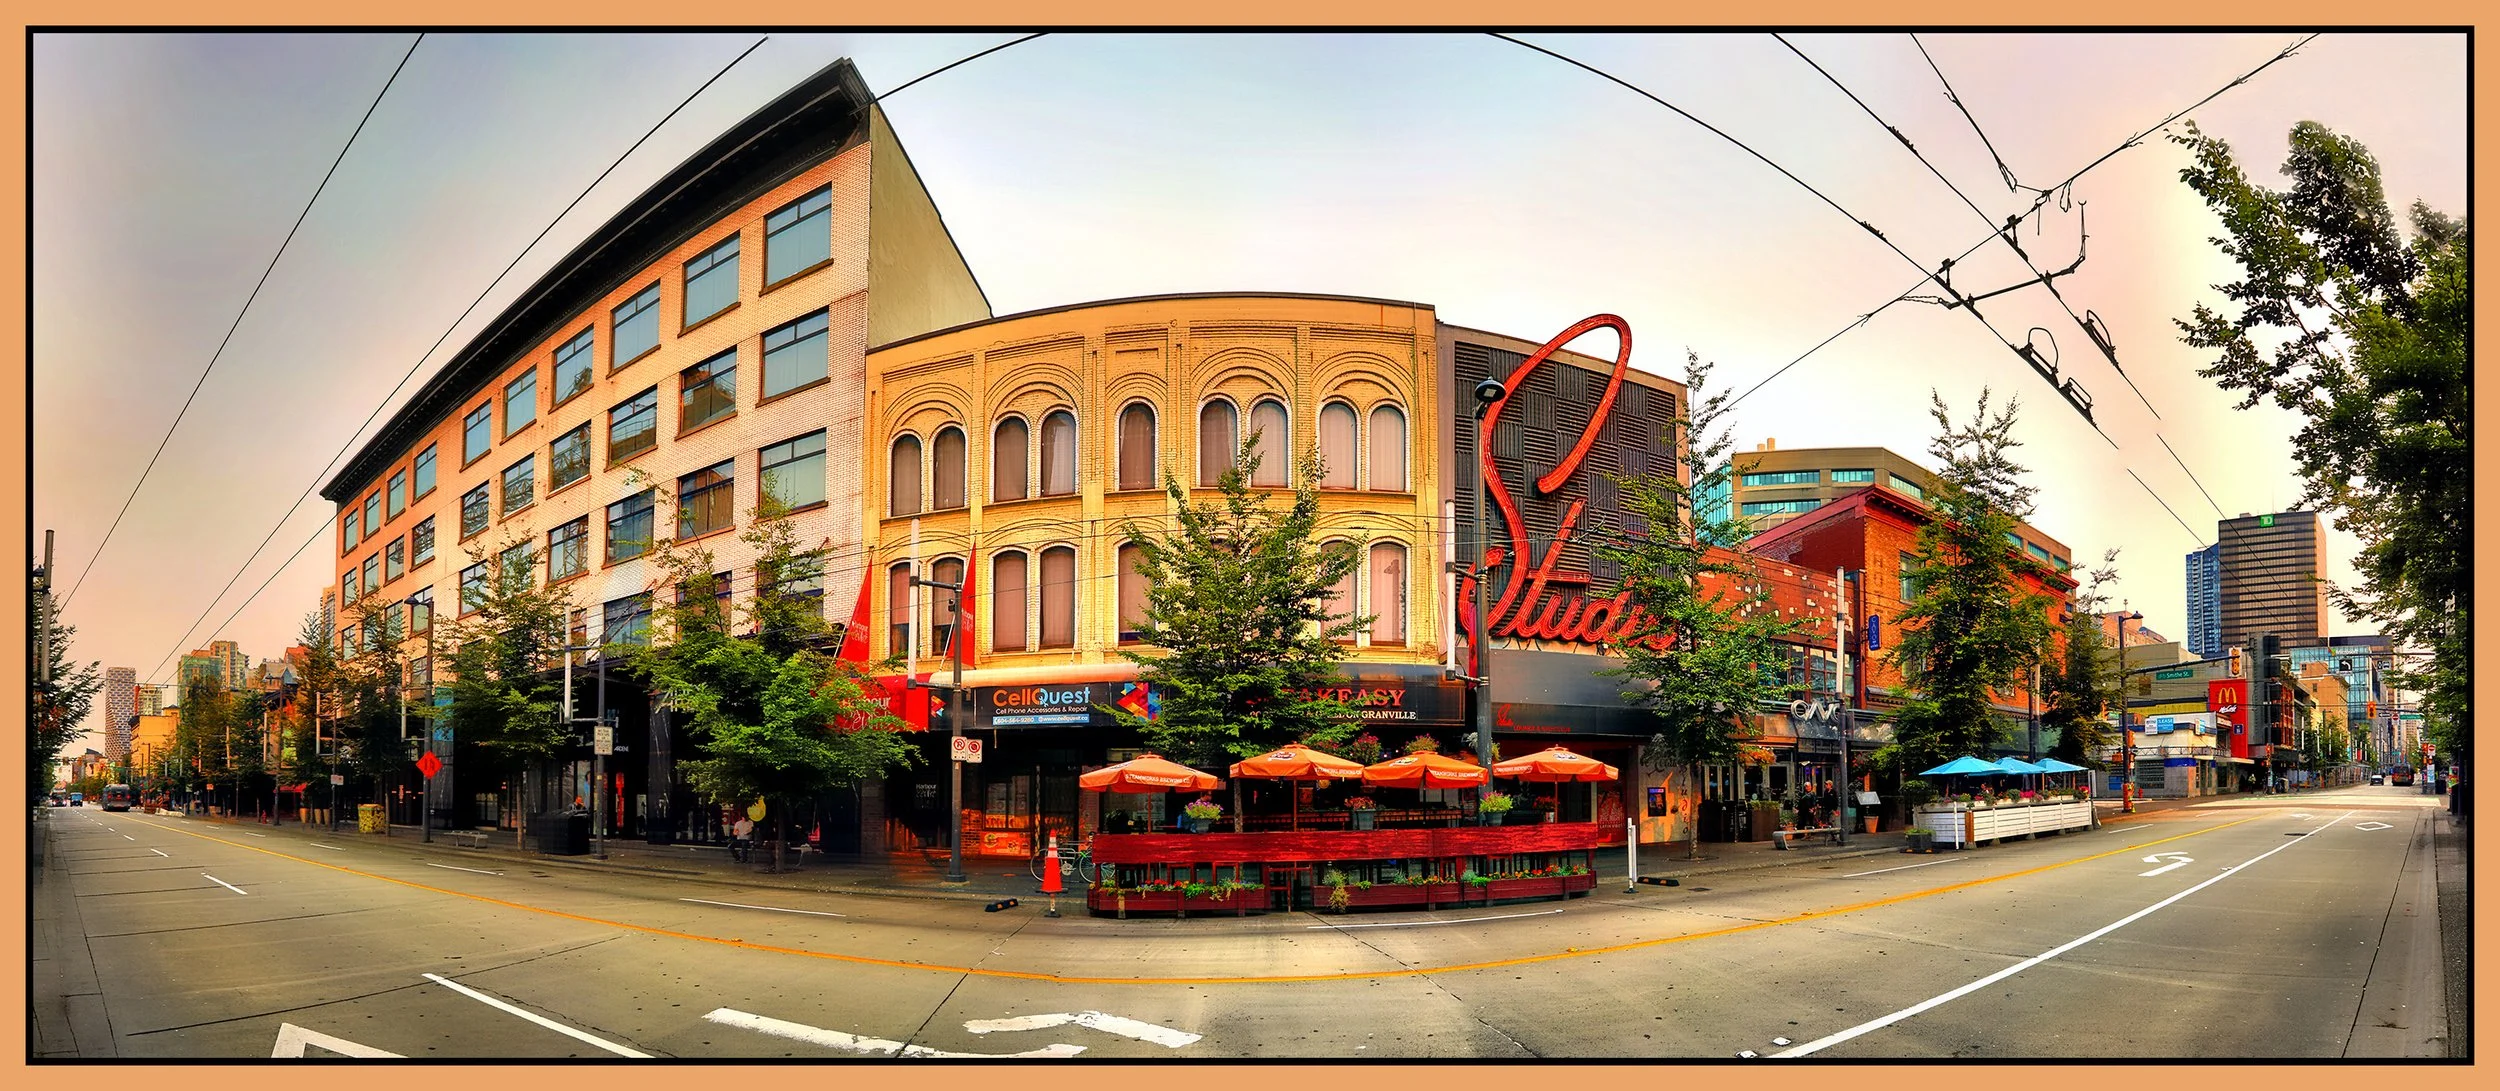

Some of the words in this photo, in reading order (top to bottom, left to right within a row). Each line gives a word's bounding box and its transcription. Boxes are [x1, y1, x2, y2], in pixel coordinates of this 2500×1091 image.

[993, 687, 1090, 706] CellQuest
[1068, 705, 1087, 713] Repair
[1361, 711, 1416, 719] GRANVILLE
